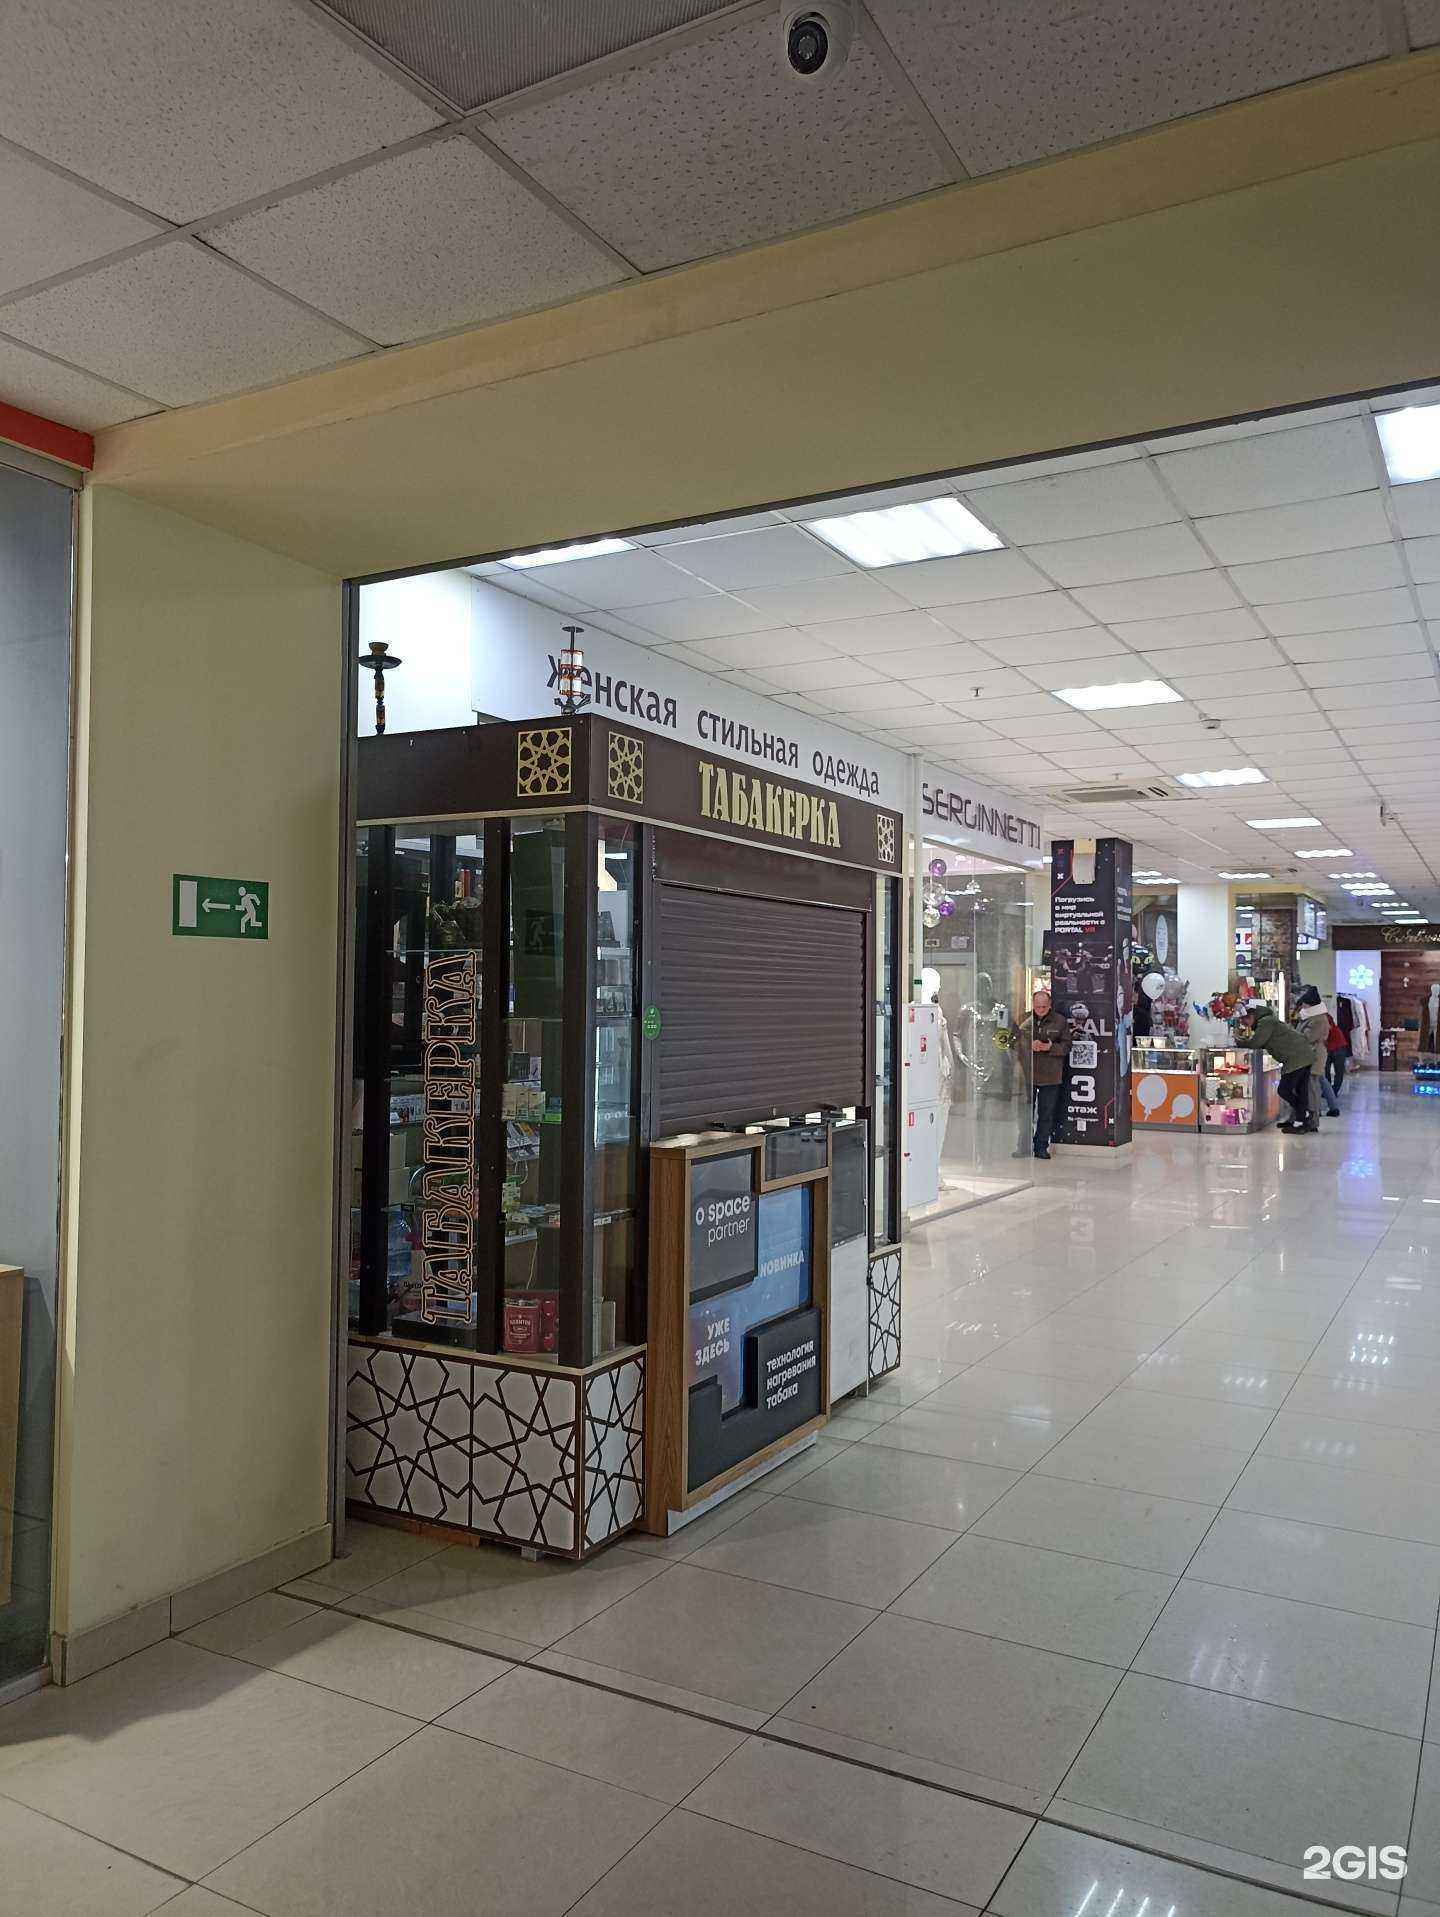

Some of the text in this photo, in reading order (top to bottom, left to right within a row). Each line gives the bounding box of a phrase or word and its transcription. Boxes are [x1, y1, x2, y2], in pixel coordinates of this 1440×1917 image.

[697, 709, 799, 768] стильная
[813, 749, 880, 797] одежда
[699, 761, 841, 848] ТАБАКЕРКА
[1070, 1075, 1096, 1102] 3
[1067, 1106, 1098, 1115] этаж
[420, 950, 476, 1326] ТАБАКЕРКА
[708, 1195, 751, 1226] space
[708, 1217, 750, 1247] partner
[759, 1249, 805, 1278] НОВИНКА
[707, 1317, 730, 1340] УЖЕ
[695, 1338, 730, 1367] ЗДЕСЬ
[766, 1340, 814, 1372] технология
[766, 1355, 816, 1390] нагревания
[766, 1382, 799, 1409] табака
